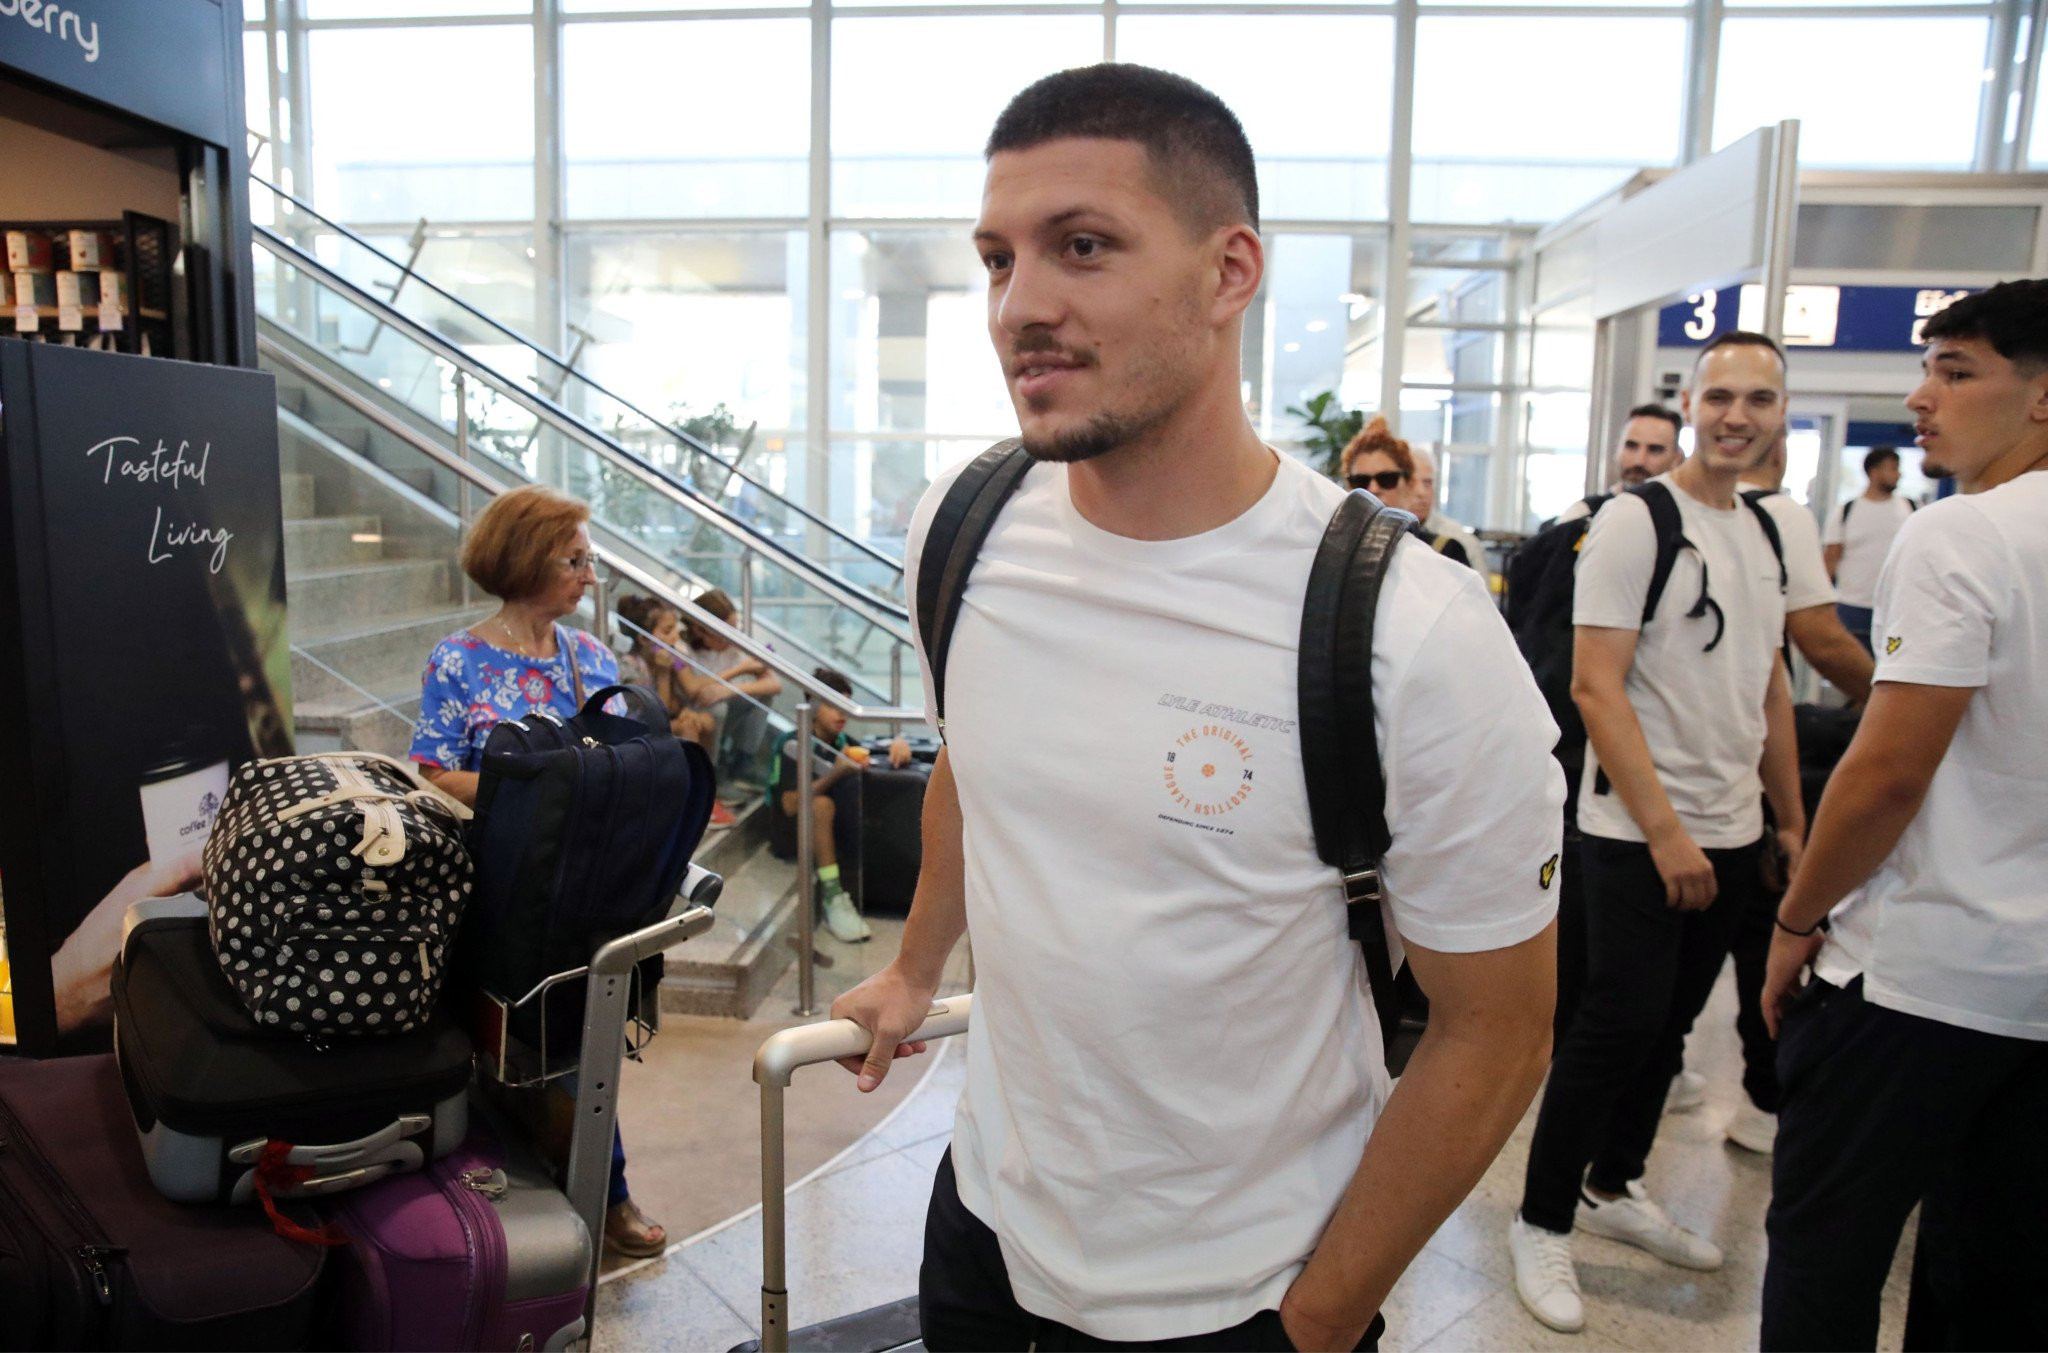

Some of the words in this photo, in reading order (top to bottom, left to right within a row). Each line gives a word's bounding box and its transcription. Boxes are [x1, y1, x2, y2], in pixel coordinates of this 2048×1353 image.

[1684, 288, 1717, 340] 3
[87, 436, 211, 490] Tasteful
[148, 506, 234, 574] Living
[1158, 694, 1200, 712] LYLE
[1199, 704, 1295, 733] ATHLETIC
[1166, 752, 1176, 762] 18
[1176, 728, 1199, 747] THE
[1202, 725, 1254, 762] ORIGINAL
[1243, 769, 1253, 780] 74
[1194, 783, 1252, 816] SCOTTISH
[1158, 814, 1194, 826] DEFENDING
[1195, 823, 1214, 831] SINCE
